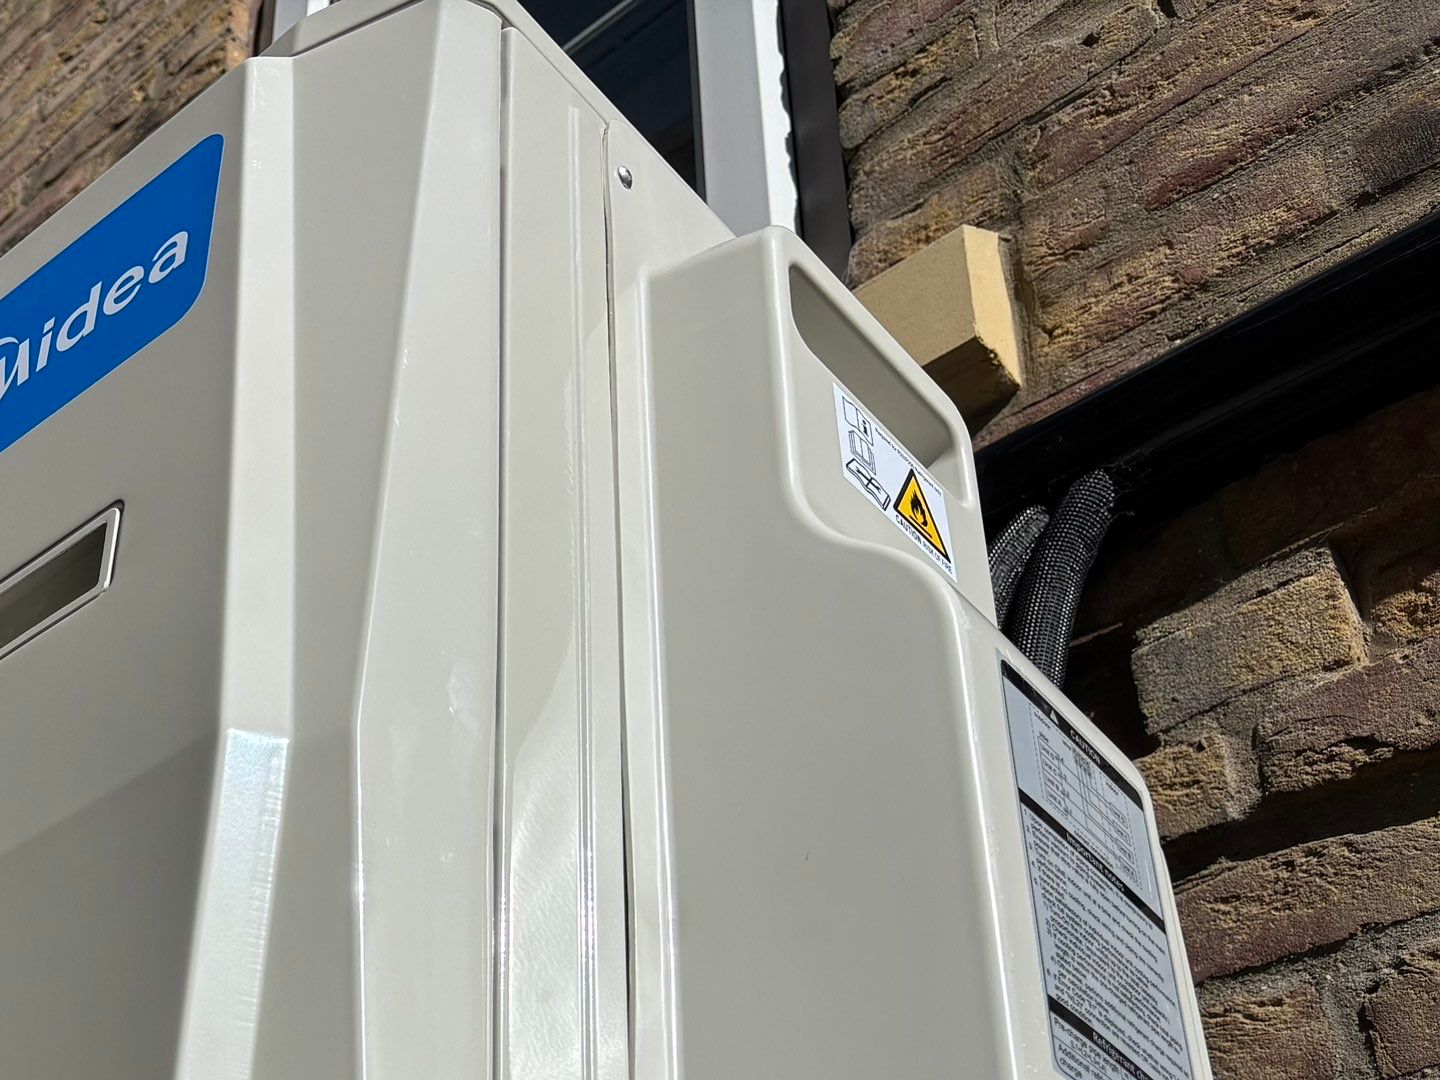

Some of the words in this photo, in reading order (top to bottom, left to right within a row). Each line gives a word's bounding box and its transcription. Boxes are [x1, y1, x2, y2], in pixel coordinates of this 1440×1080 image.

[895, 514, 921, 544] CAUTION
[1069, 729, 1100, 765] CAUTION
[1066, 833, 1103, 875] Important
[1104, 869, 1124, 893] notes
[1092, 1031, 1135, 1075] Refrigerant
